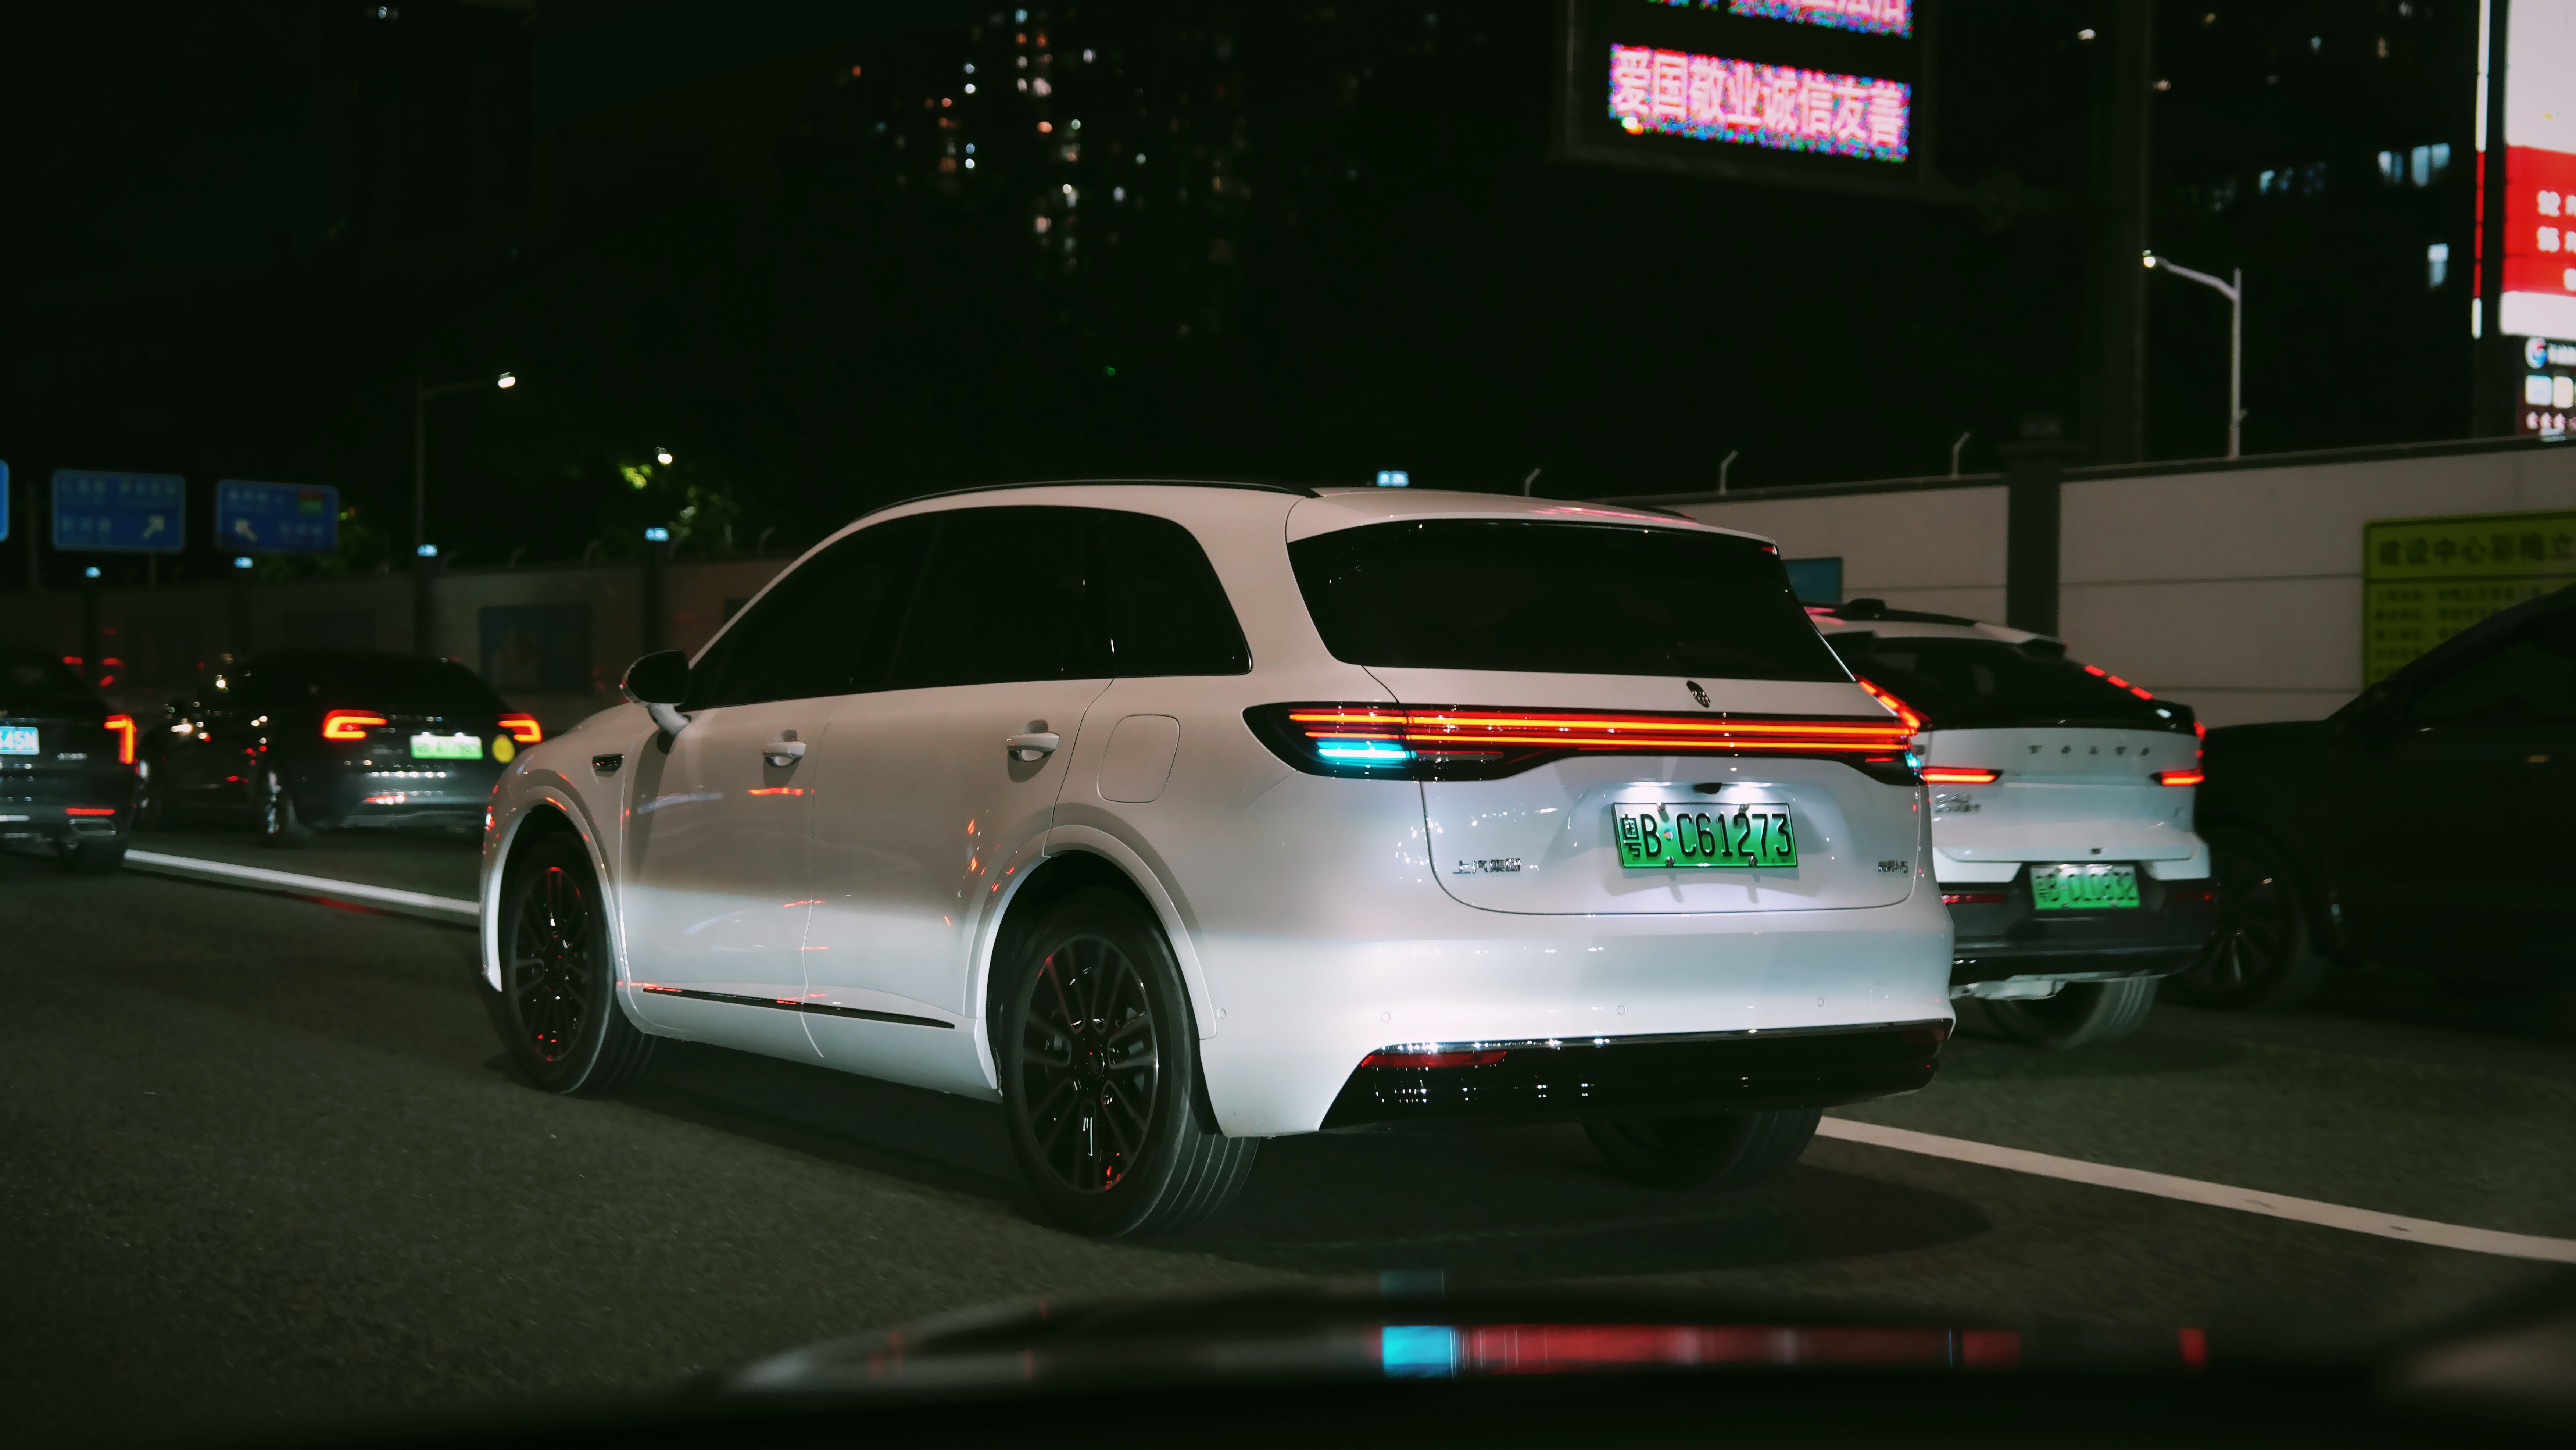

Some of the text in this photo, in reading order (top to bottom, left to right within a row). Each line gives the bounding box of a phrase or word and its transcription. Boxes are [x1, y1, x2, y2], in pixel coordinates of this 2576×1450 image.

[1612, 46, 1906, 148] 爱国敬业诚信友善
